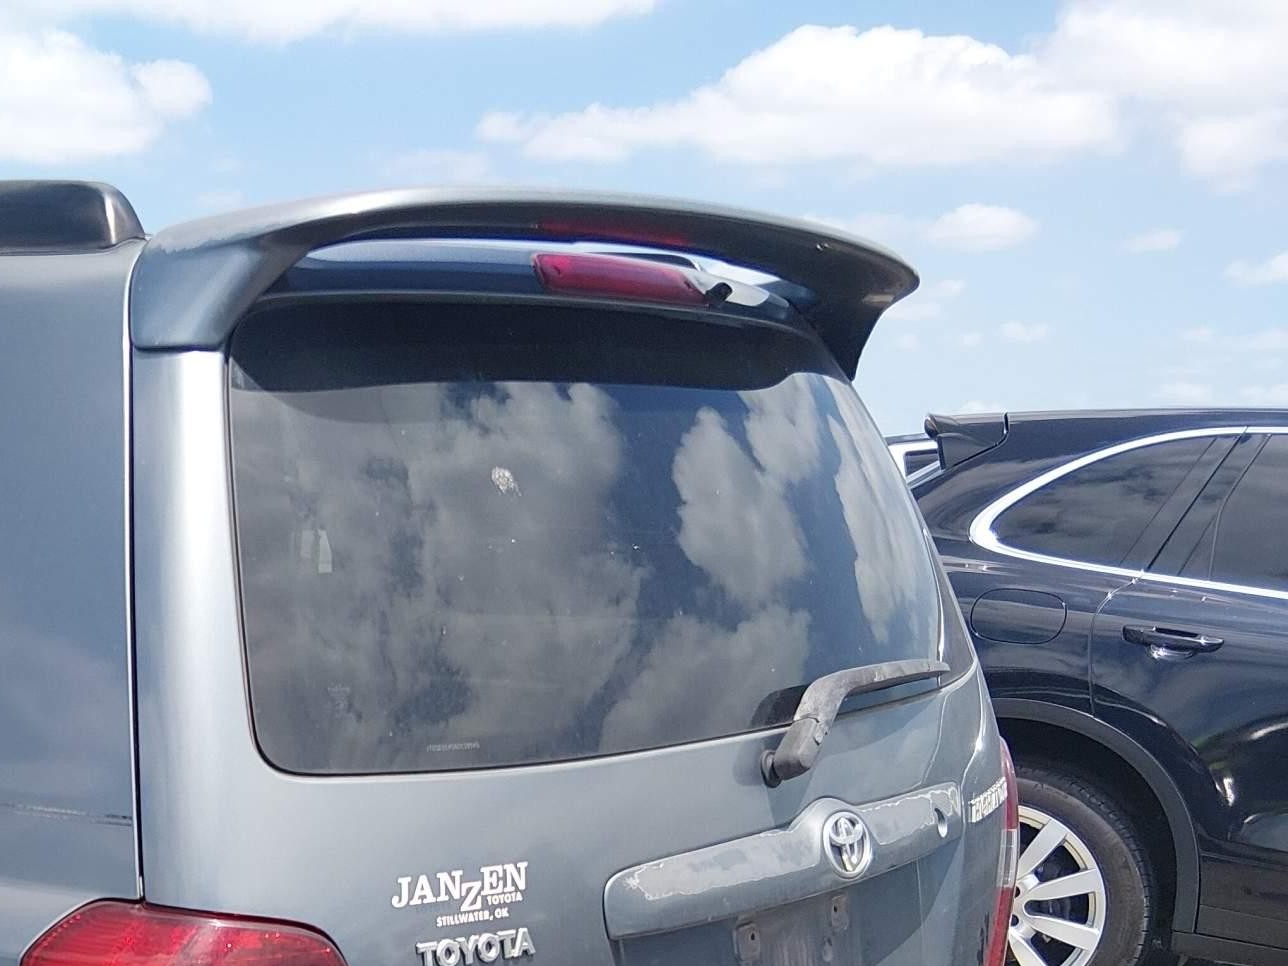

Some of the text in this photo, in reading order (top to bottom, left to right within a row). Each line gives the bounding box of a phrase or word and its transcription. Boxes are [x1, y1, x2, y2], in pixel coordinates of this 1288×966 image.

[391, 861, 529, 912] JANZEN
[486, 891, 523, 905] TOYOTA
[436, 907, 509, 927] STILLWATER, OK
